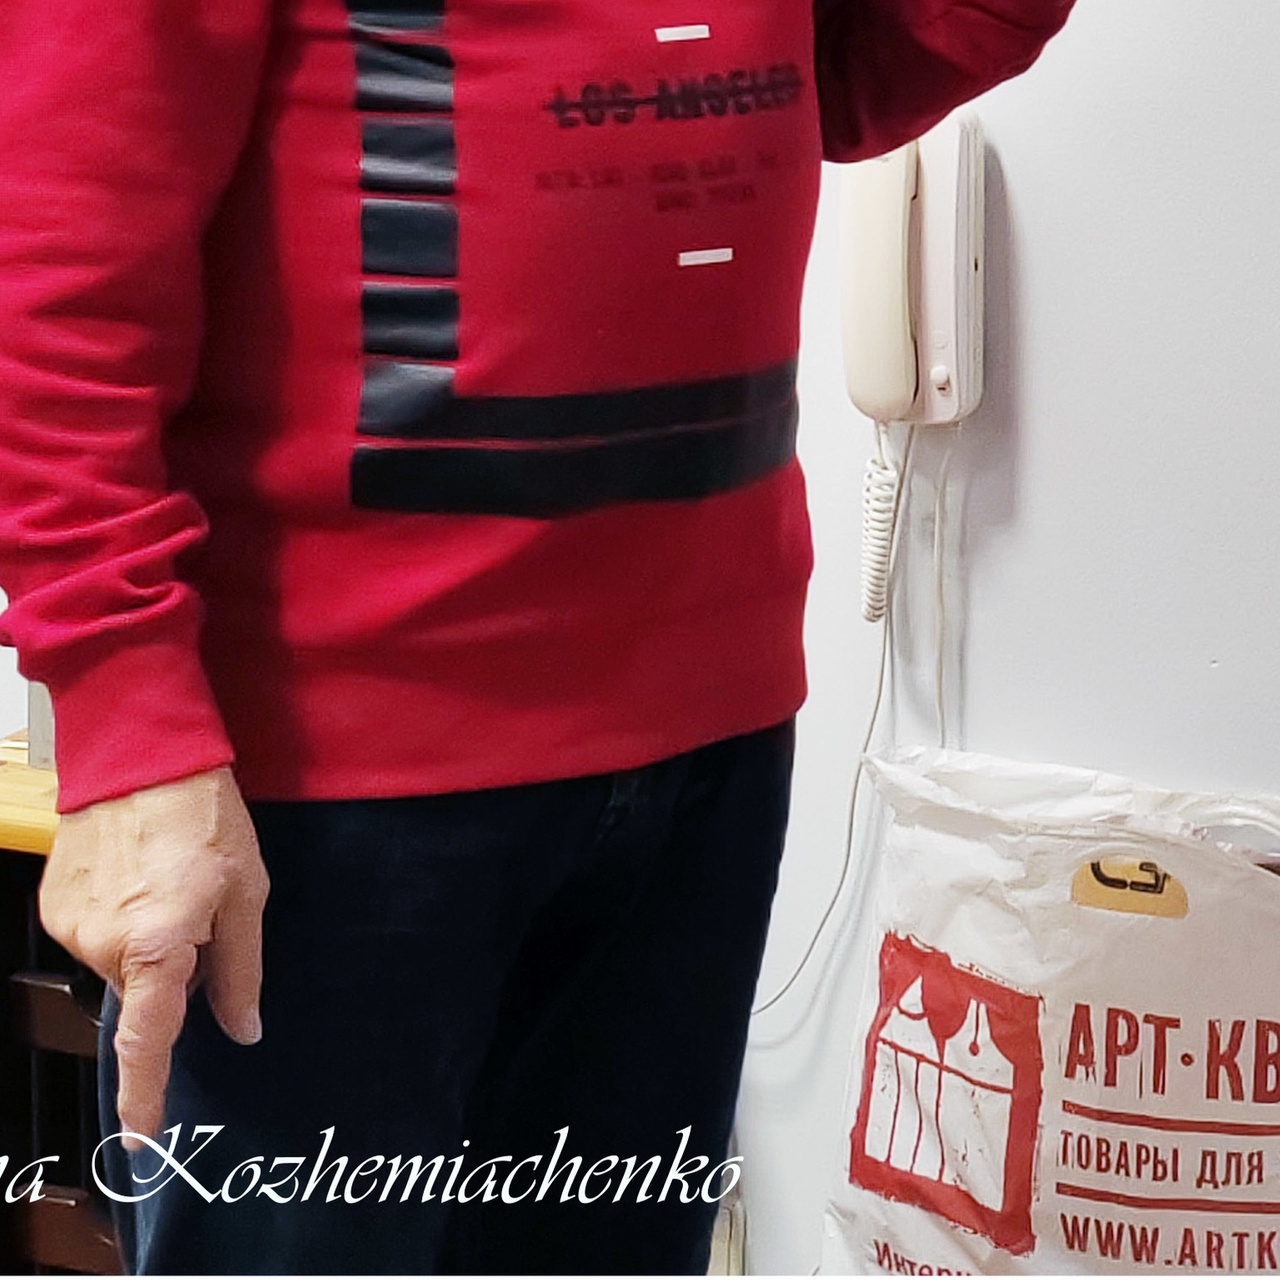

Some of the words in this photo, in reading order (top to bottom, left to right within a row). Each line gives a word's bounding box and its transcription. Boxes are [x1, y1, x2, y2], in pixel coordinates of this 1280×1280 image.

[550, 82, 637, 129] LOS
[1059, 1129, 1180, 1184] ТОВАРЫ
[1196, 1149, 1265, 1190] ДЛЯ
